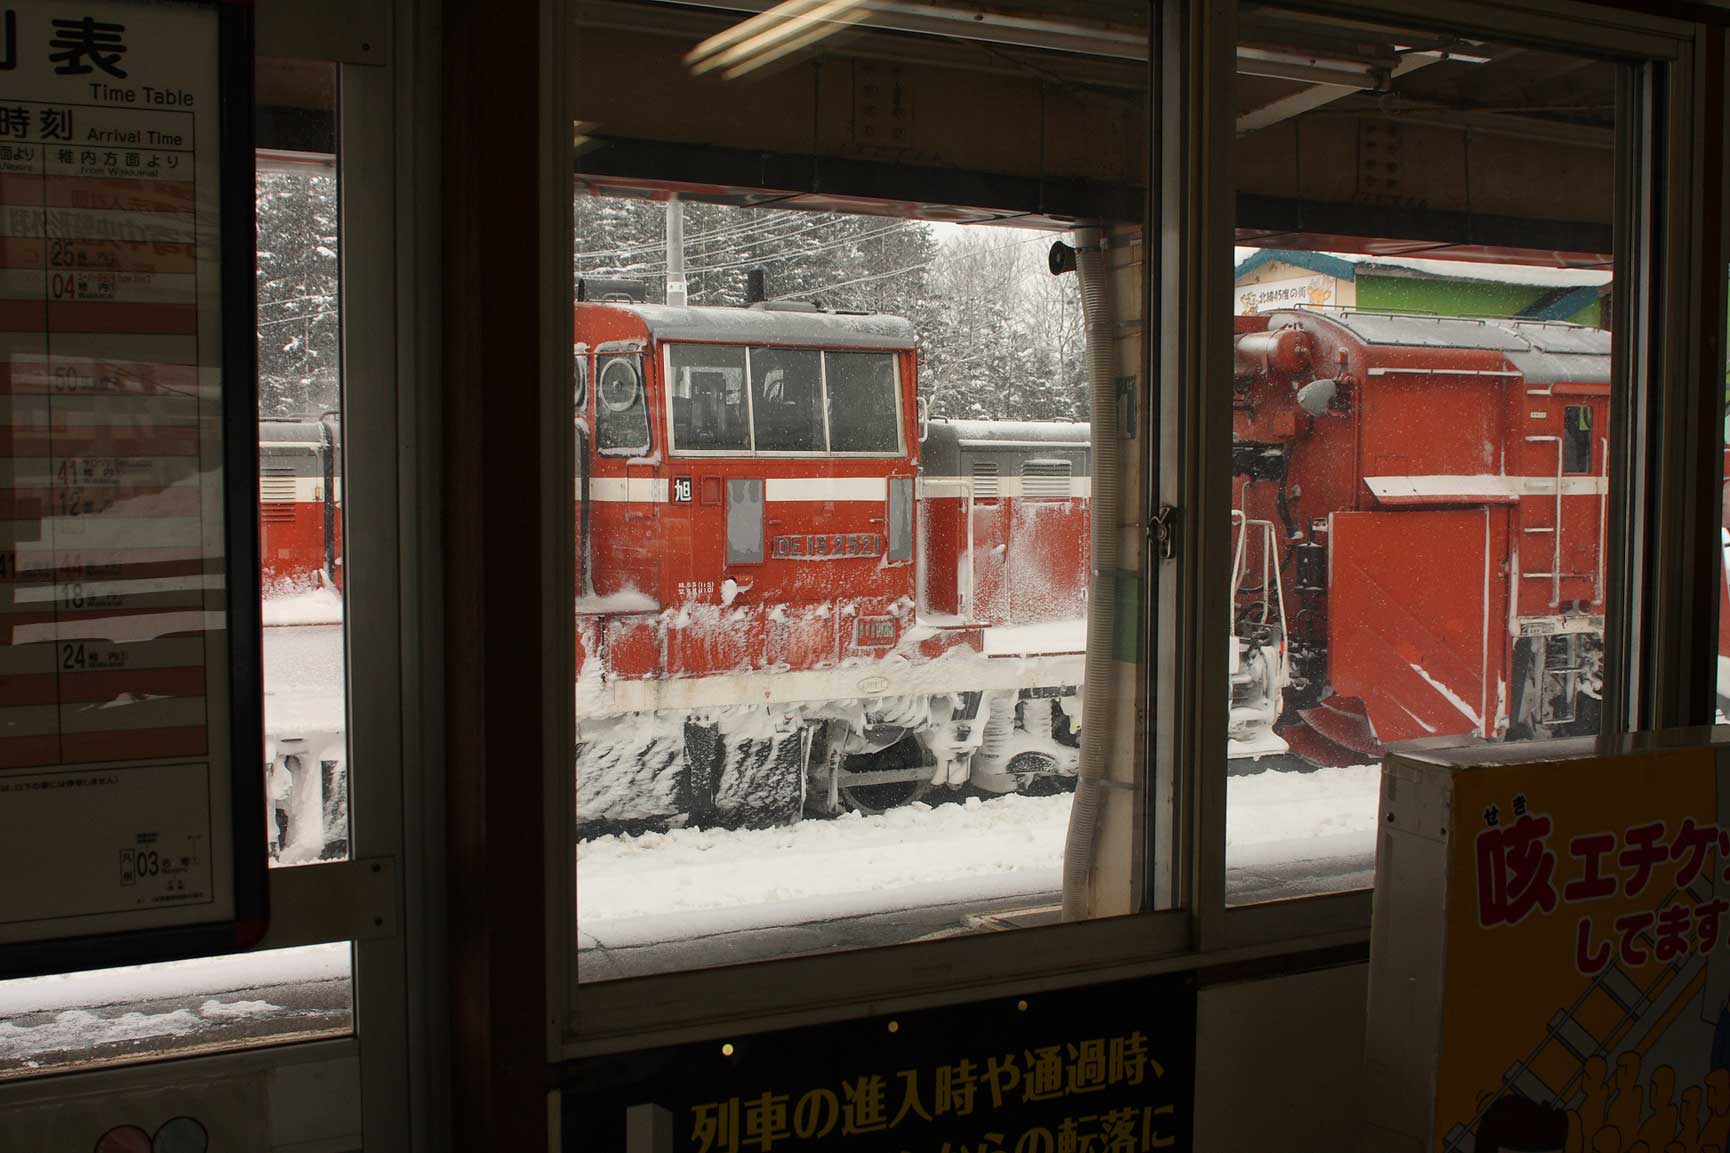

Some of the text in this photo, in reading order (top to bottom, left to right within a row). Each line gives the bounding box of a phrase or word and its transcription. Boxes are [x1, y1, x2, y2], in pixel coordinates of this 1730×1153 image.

[89, 83, 194, 106] Time Table
[87, 127, 182, 146] Arrival Time
[58, 148, 179, 168] 稚内方面より
[52, 273, 76, 299] 04
[674, 479, 692, 502] 旭
[63, 643, 85, 669] 24
[1483, 795, 1527, 827] せき
[137, 851, 159, 877] 03
